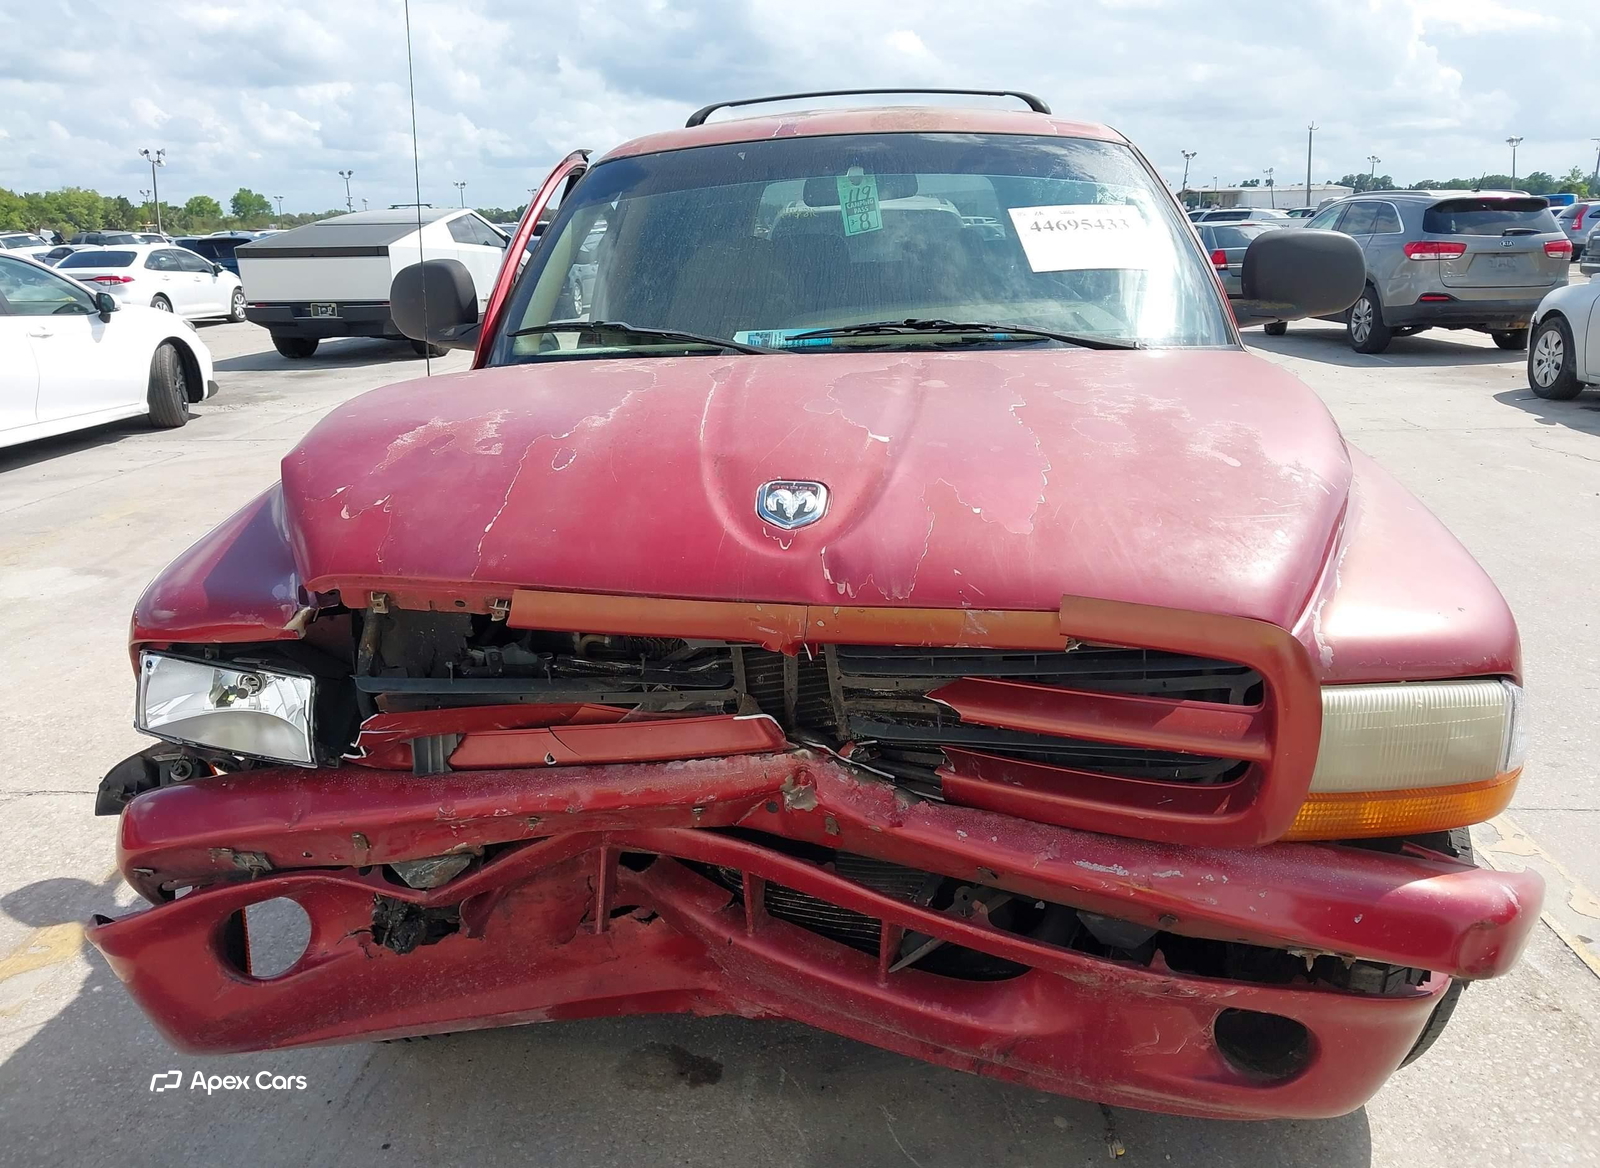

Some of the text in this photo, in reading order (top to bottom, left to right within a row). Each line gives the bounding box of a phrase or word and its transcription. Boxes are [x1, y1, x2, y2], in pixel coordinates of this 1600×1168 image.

[846, 199, 874, 209] CAMPING
[854, 206, 869, 214] PASS
[1030, 219, 1130, 232] 44695433
